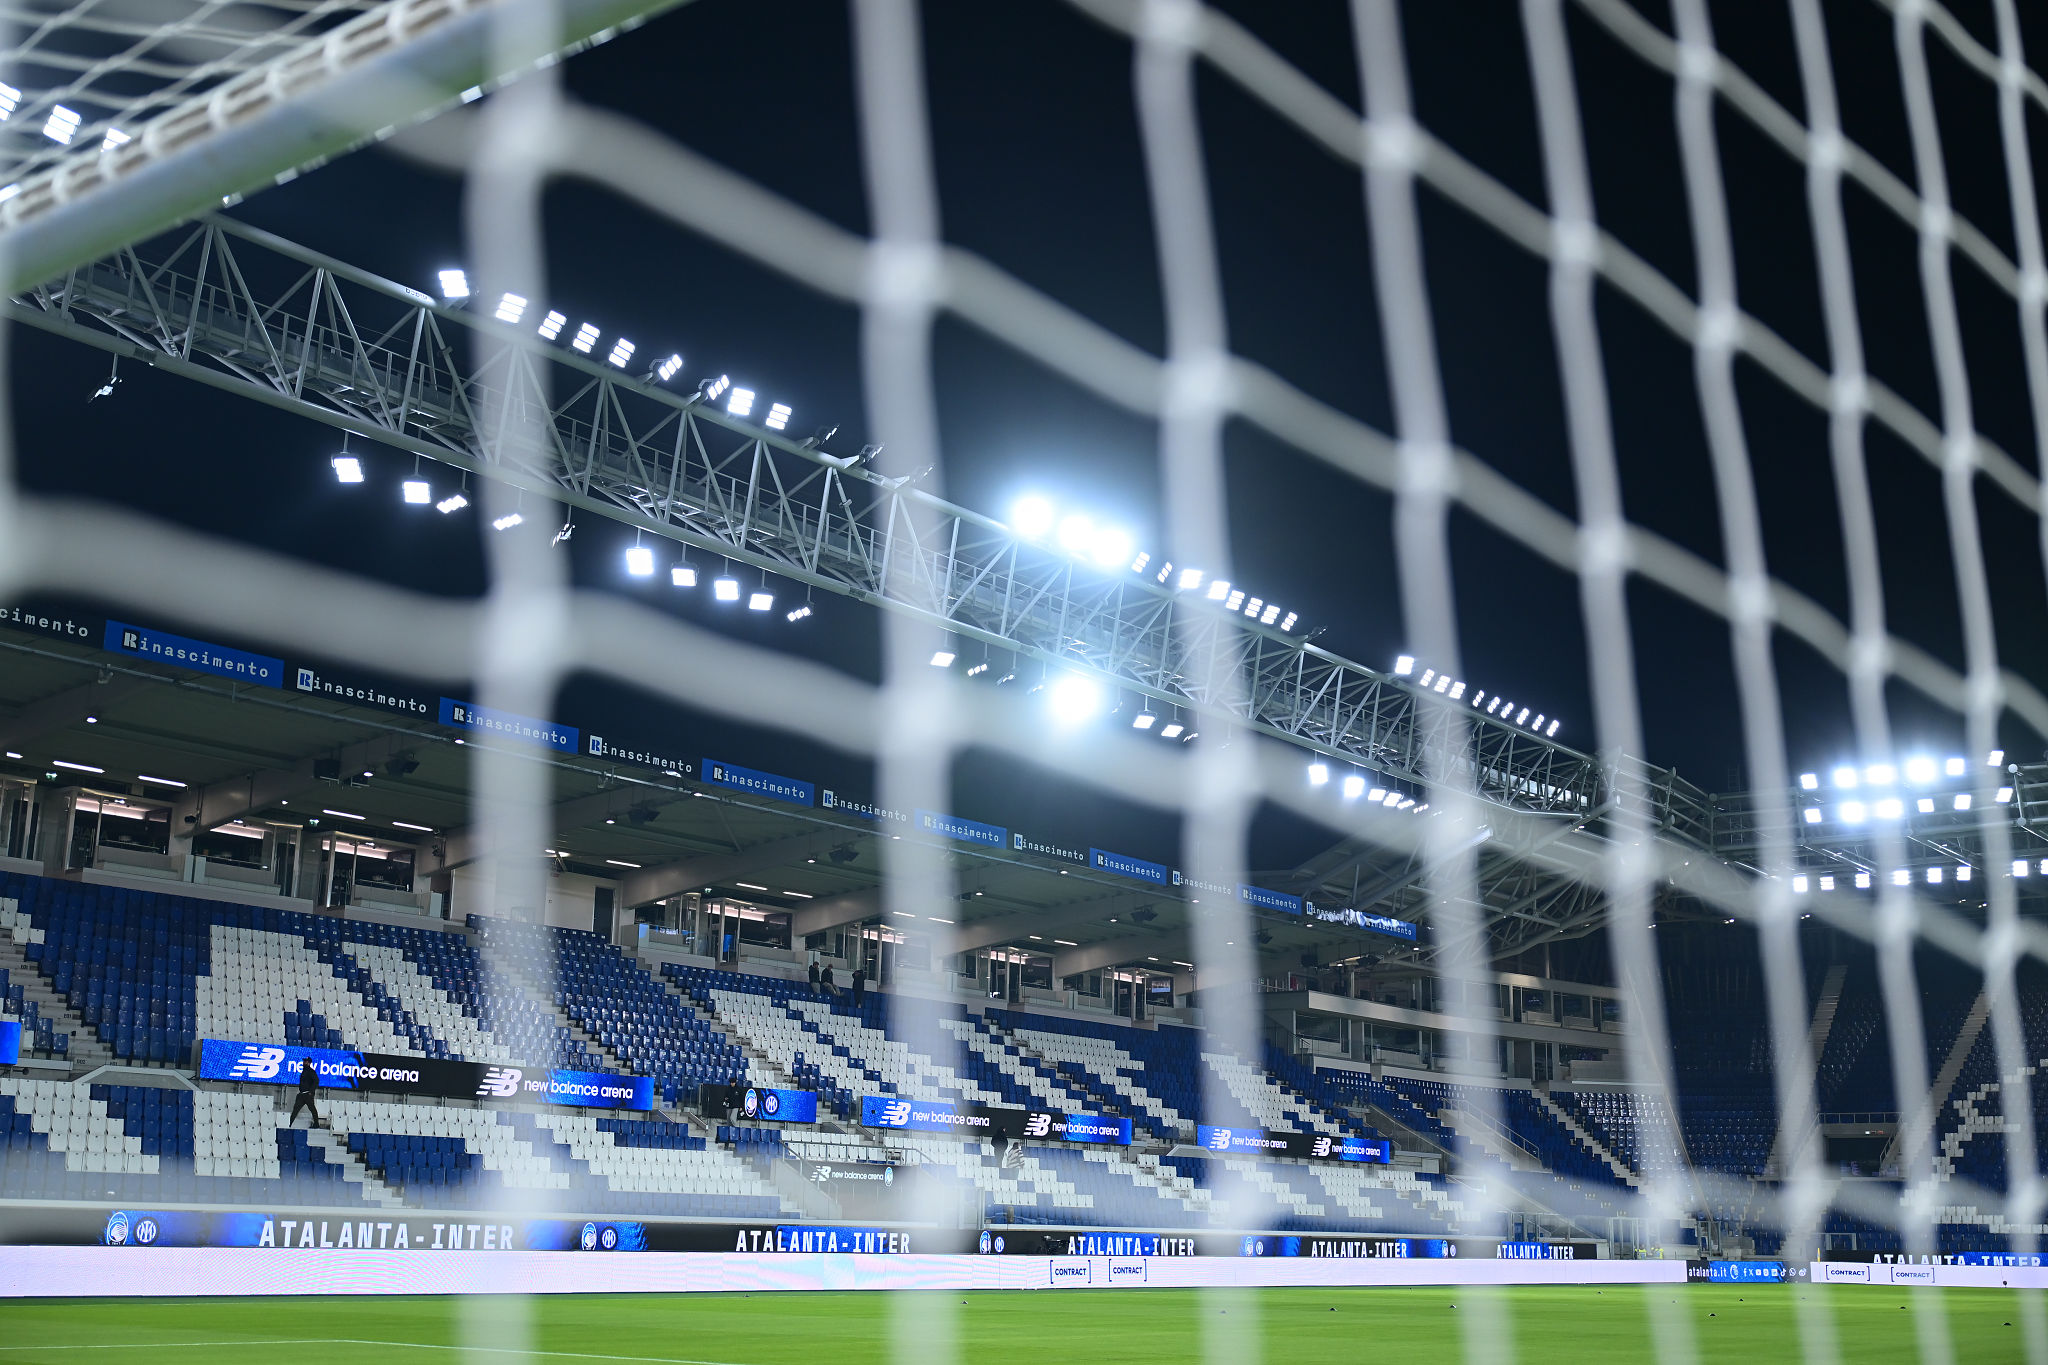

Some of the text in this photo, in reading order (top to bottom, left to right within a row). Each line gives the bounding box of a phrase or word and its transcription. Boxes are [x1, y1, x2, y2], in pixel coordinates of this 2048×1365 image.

[124, 632, 269, 678] Rinascimento
[299, 669, 427, 714] Rinascimento
[454, 707, 567, 745] Rinascimento
[590, 736, 692, 773] Rinascimento
[713, 767, 805, 799] Rinascimento
[823, 790, 907, 822] Rinascimento
[924, 815, 999, 843] Rinascimento
[1014, 834, 1084, 861] Rinascimento
[1097, 854, 1161, 879] Rinascimento
[1173, 871, 1232, 895] Rinascimento
[1243, 889, 1297, 910] Rinascimento
[320, 1060, 377, 1079] balance
[381, 1067, 419, 1083] arena
[524, 1079, 549, 1092] new
[551, 1079, 598, 1096] balance
[601, 1086, 633, 1099] arena
[912, 1111, 930, 1122] new
[931, 1112, 965, 1125] balance
[966, 1116, 990, 1127] arena
[1052, 1122, 1068, 1133] new
[1068, 1122, 1098, 1134] balance
[1099, 1126, 1119, 1137] arena
[1232, 1137, 1245, 1146] new
[1245, 1137, 1269, 1148] balance
[1270, 1140, 1287, 1149] arena
[1332, 1144, 1343, 1153] new
[1343, 1144, 1365, 1155] balance
[1366, 1147, 1380, 1156] arena
[832, 1171, 843, 1179] new
[844, 1171, 867, 1180] balance
[867, 1172, 884, 1181] arena
[259, 1221, 514, 1250] ATALANTA-INTER
[736, 1230, 910, 1254] ATALANTA-INTER
[1068, 1236, 1195, 1256] ATALANTA-INTER
[1311, 1241, 1407, 1258] ATALANTA-INTER
[1496, 1244, 1574, 1260] ATALANTA-INTER
[1054, 1268, 1087, 1277] CONTRACT
[1112, 1266, 1143, 1275] CONTRACT
[1688, 1266, 1727, 1277] atalanta.it
